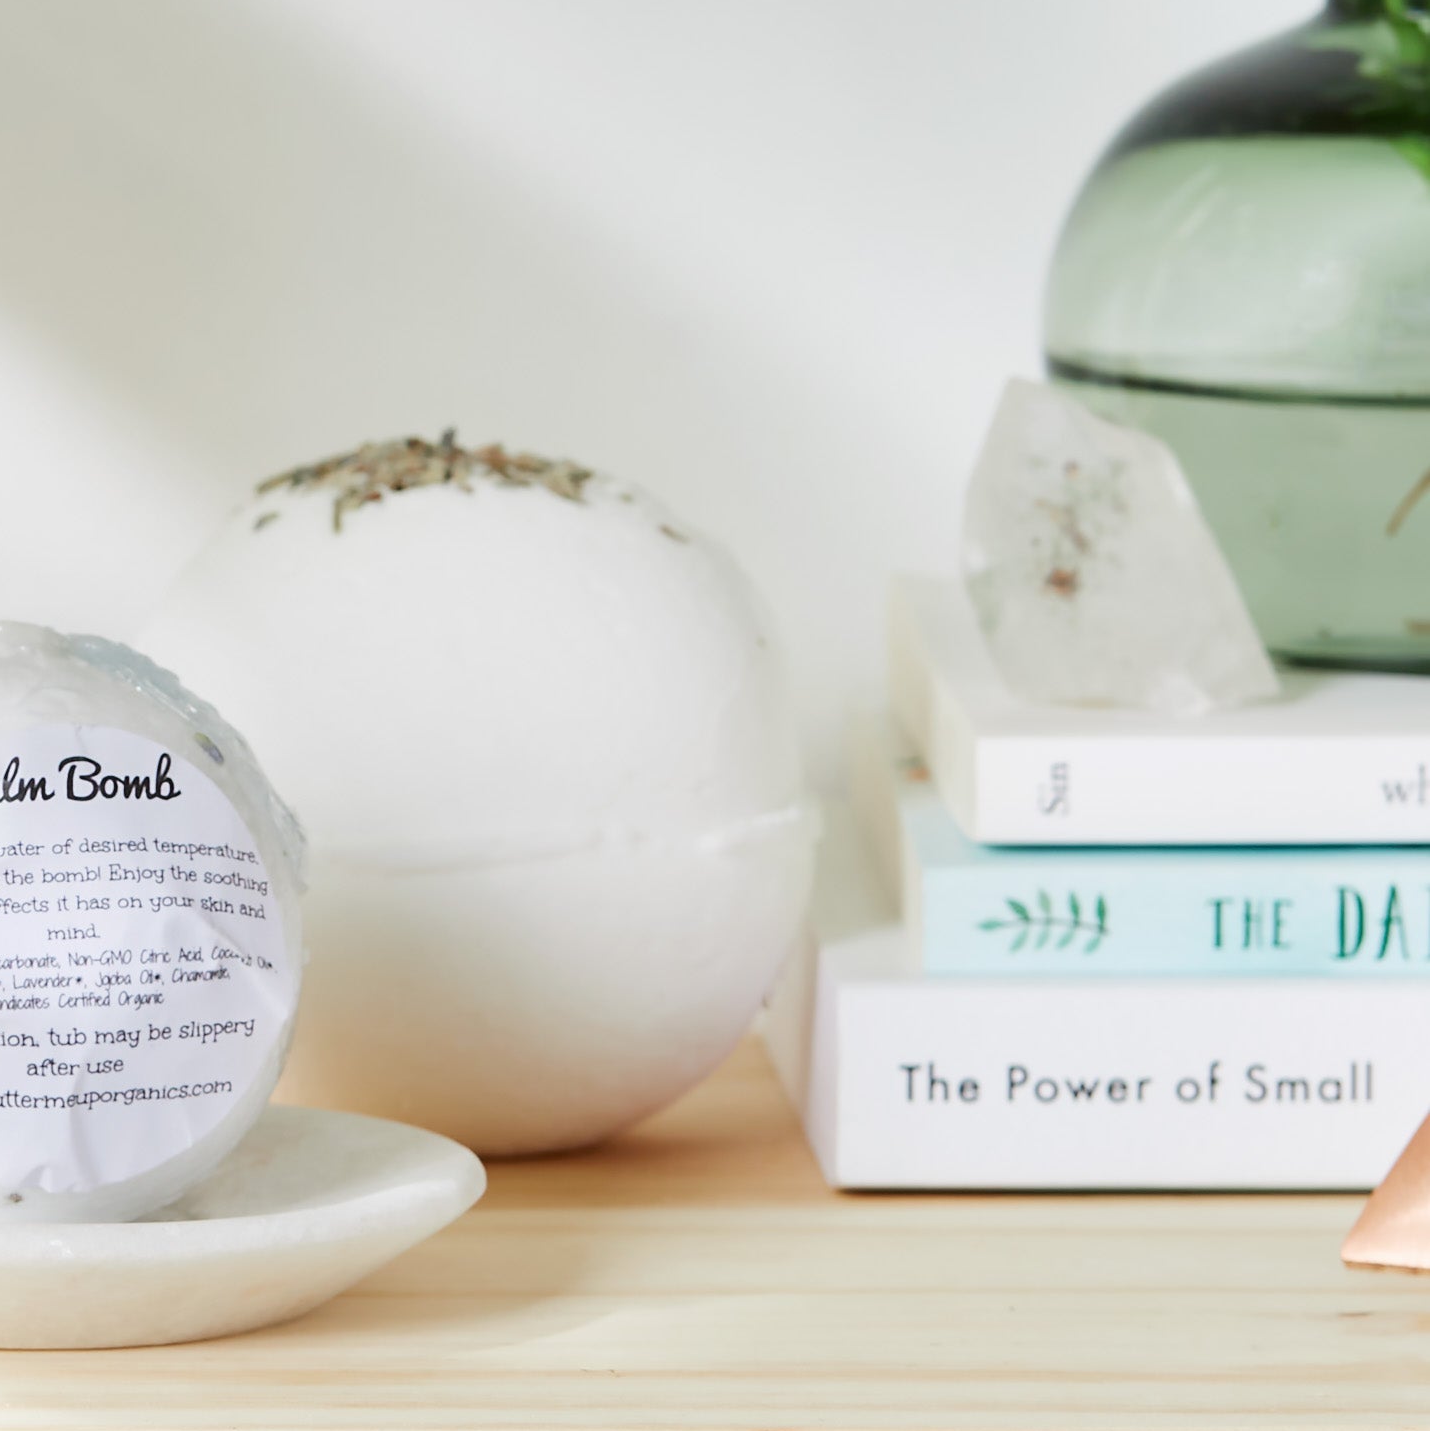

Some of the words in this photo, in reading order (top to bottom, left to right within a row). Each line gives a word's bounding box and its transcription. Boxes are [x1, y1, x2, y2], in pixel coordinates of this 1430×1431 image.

[58, 753, 181, 801] Bomb
[51, 838, 73, 855] of
[79, 837, 148, 854] desired
[3, 869, 34, 886] the
[109, 864, 165, 883] Enjoy
[170, 866, 198, 883] the
[203, 871, 268, 896] soothing
[57, 896, 69, 912] it
[76, 895, 110, 911] has
[117, 896, 143, 910] on
[149, 895, 195, 912] your
[200, 895, 234, 914] skin
[239, 904, 266, 920] and
[47, 922, 100, 941] mind.
[1207, 897, 1293, 950] THE
[1330, 881, 1430, 961] DA
[68, 949, 132, 966] Non-GMO
[140, 948, 171, 965] Citric
[94, 972, 132, 991] Jojoba
[58, 989, 110, 1008] Certified
[118, 990, 165, 1010] Organic
[47, 1027, 87, 1047] tub
[95, 1028, 141, 1048] may
[148, 1023, 172, 1041] be
[178, 1019, 255, 1044] slippery
[26, 1058, 80, 1077] after
[86, 1058, 124, 1074] use
[899, 1060, 981, 1104] The
[1006, 1061, 1153, 1104] Power
[1174, 1059, 1222, 1104] of
[1244, 1061, 1376, 1104] Small
